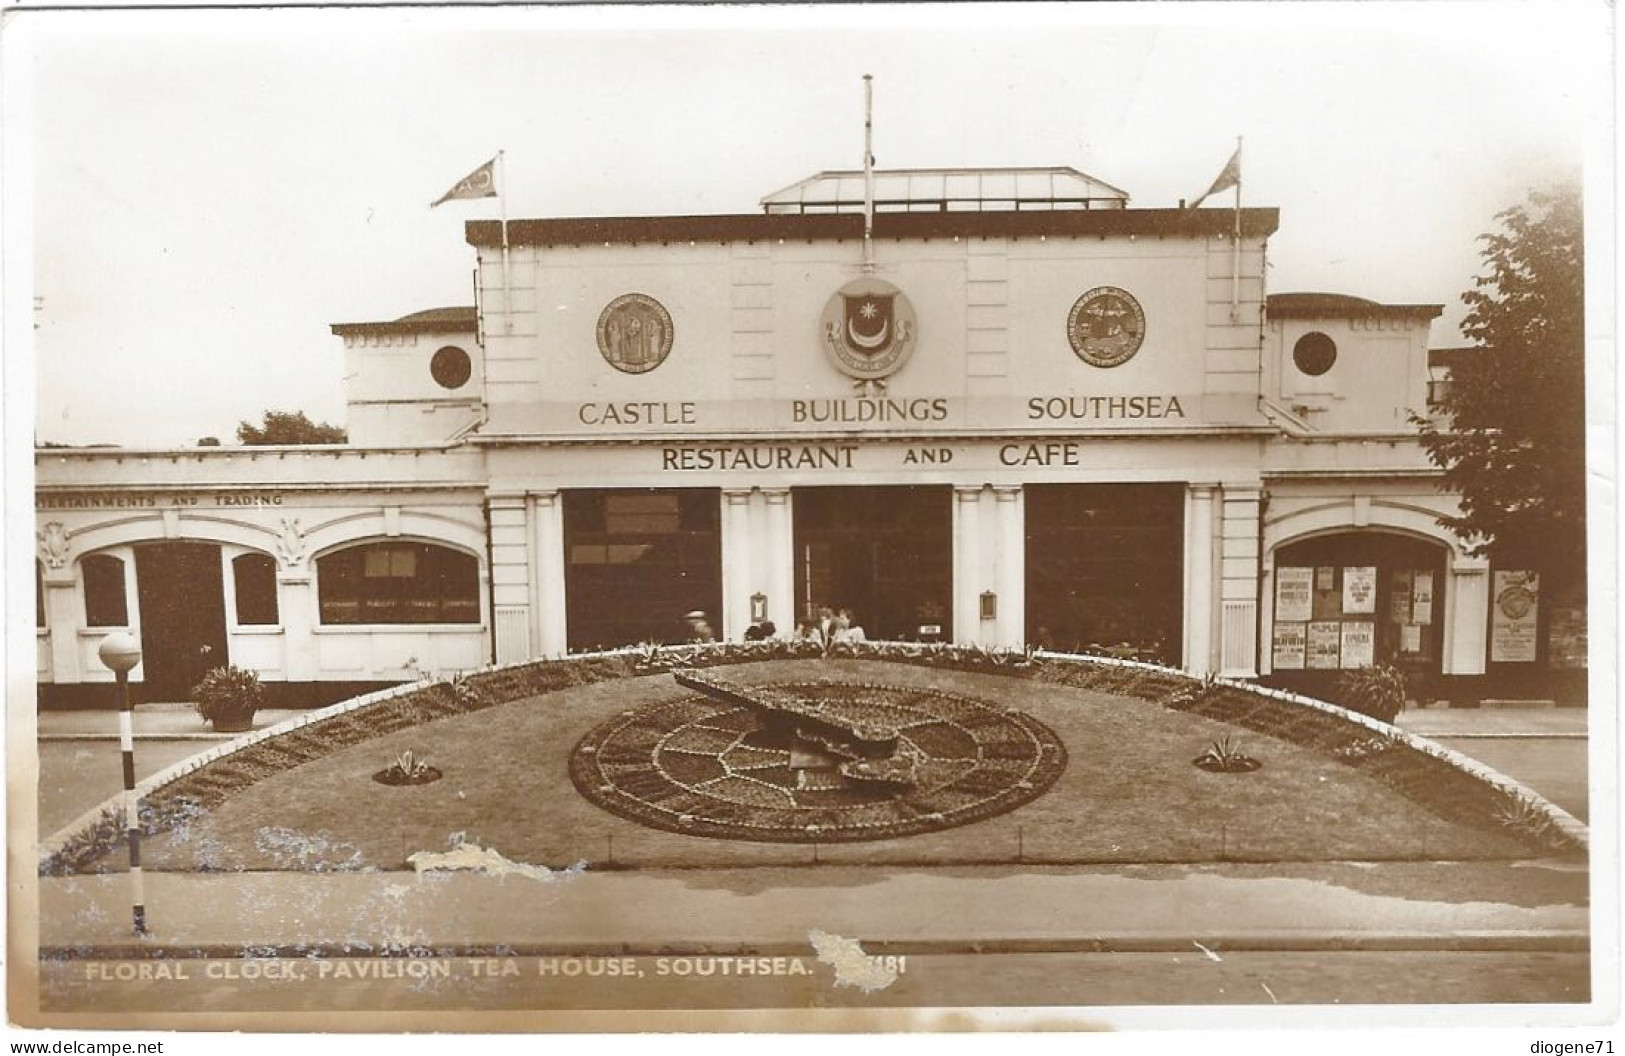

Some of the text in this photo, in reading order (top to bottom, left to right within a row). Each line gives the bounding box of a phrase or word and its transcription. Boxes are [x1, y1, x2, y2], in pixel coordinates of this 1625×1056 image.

[579, 396, 1184, 424] CASTLE BUILDINGS SOUTHSEA
[662, 443, 1080, 470] RESTAURANT AND CAFE
[36, 495, 283, 508] TERTAINMENTS AND TRADING
